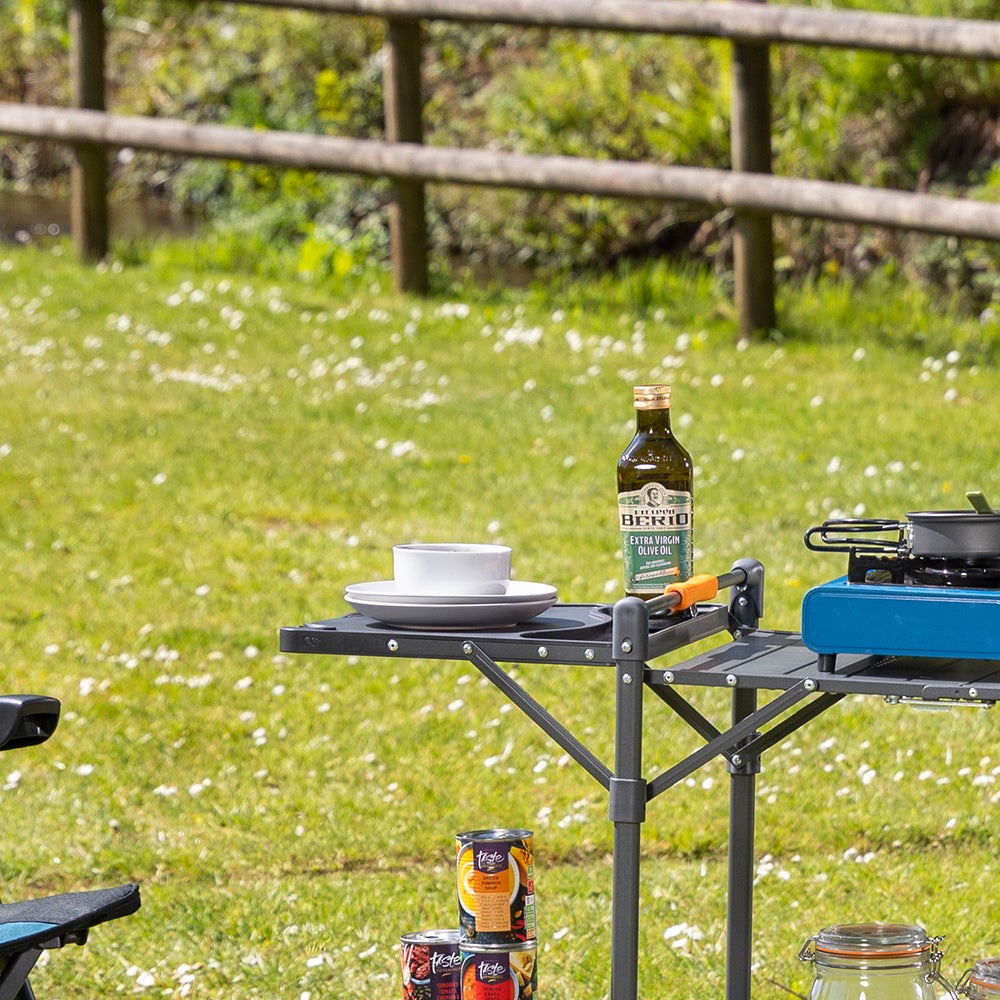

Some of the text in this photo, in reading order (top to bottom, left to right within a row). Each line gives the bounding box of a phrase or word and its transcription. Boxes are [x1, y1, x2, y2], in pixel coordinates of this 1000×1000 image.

[621, 513, 689, 526] BERIO
[630, 535, 680, 545] EXTRA VIRGIN
[637, 545, 673, 556] OLIVE OIL
